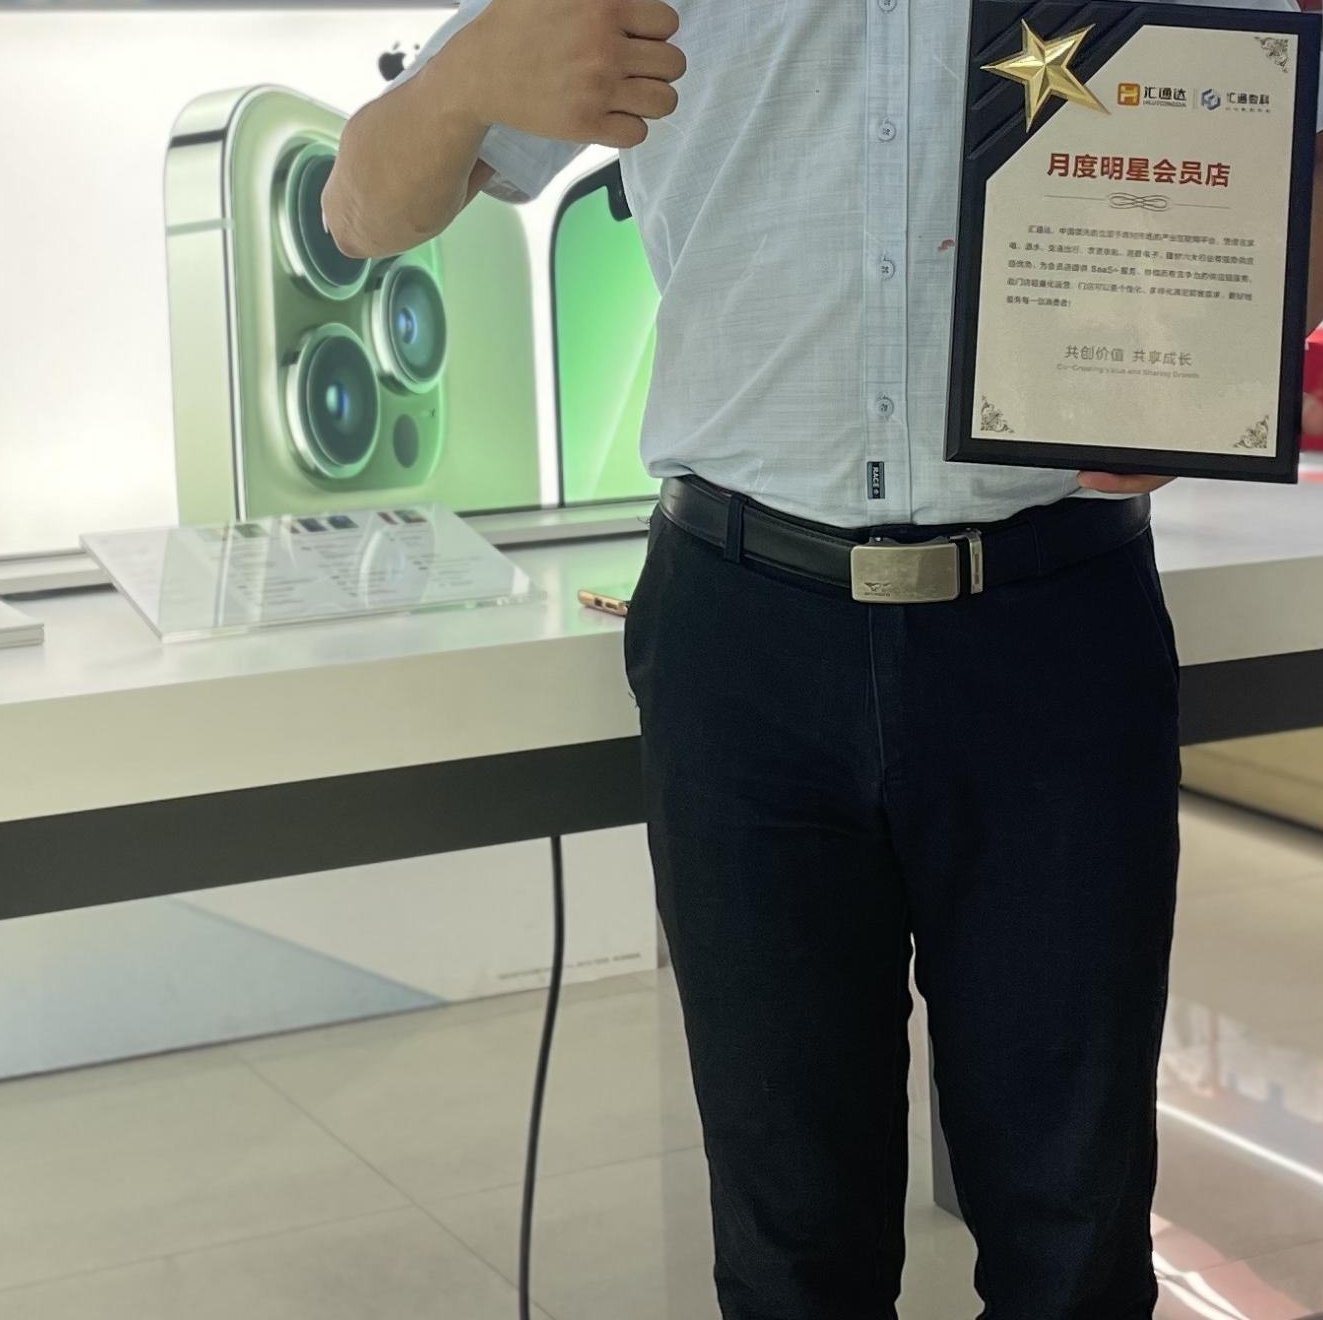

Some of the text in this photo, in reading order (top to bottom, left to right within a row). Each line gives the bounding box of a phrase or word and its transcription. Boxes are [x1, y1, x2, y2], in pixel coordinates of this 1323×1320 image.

[1143, 85, 1187, 101] 汇通达
[1047, 152, 1231, 188] 月度明星会员店
[1064, 344, 1193, 367] 共创价值 共享成长
